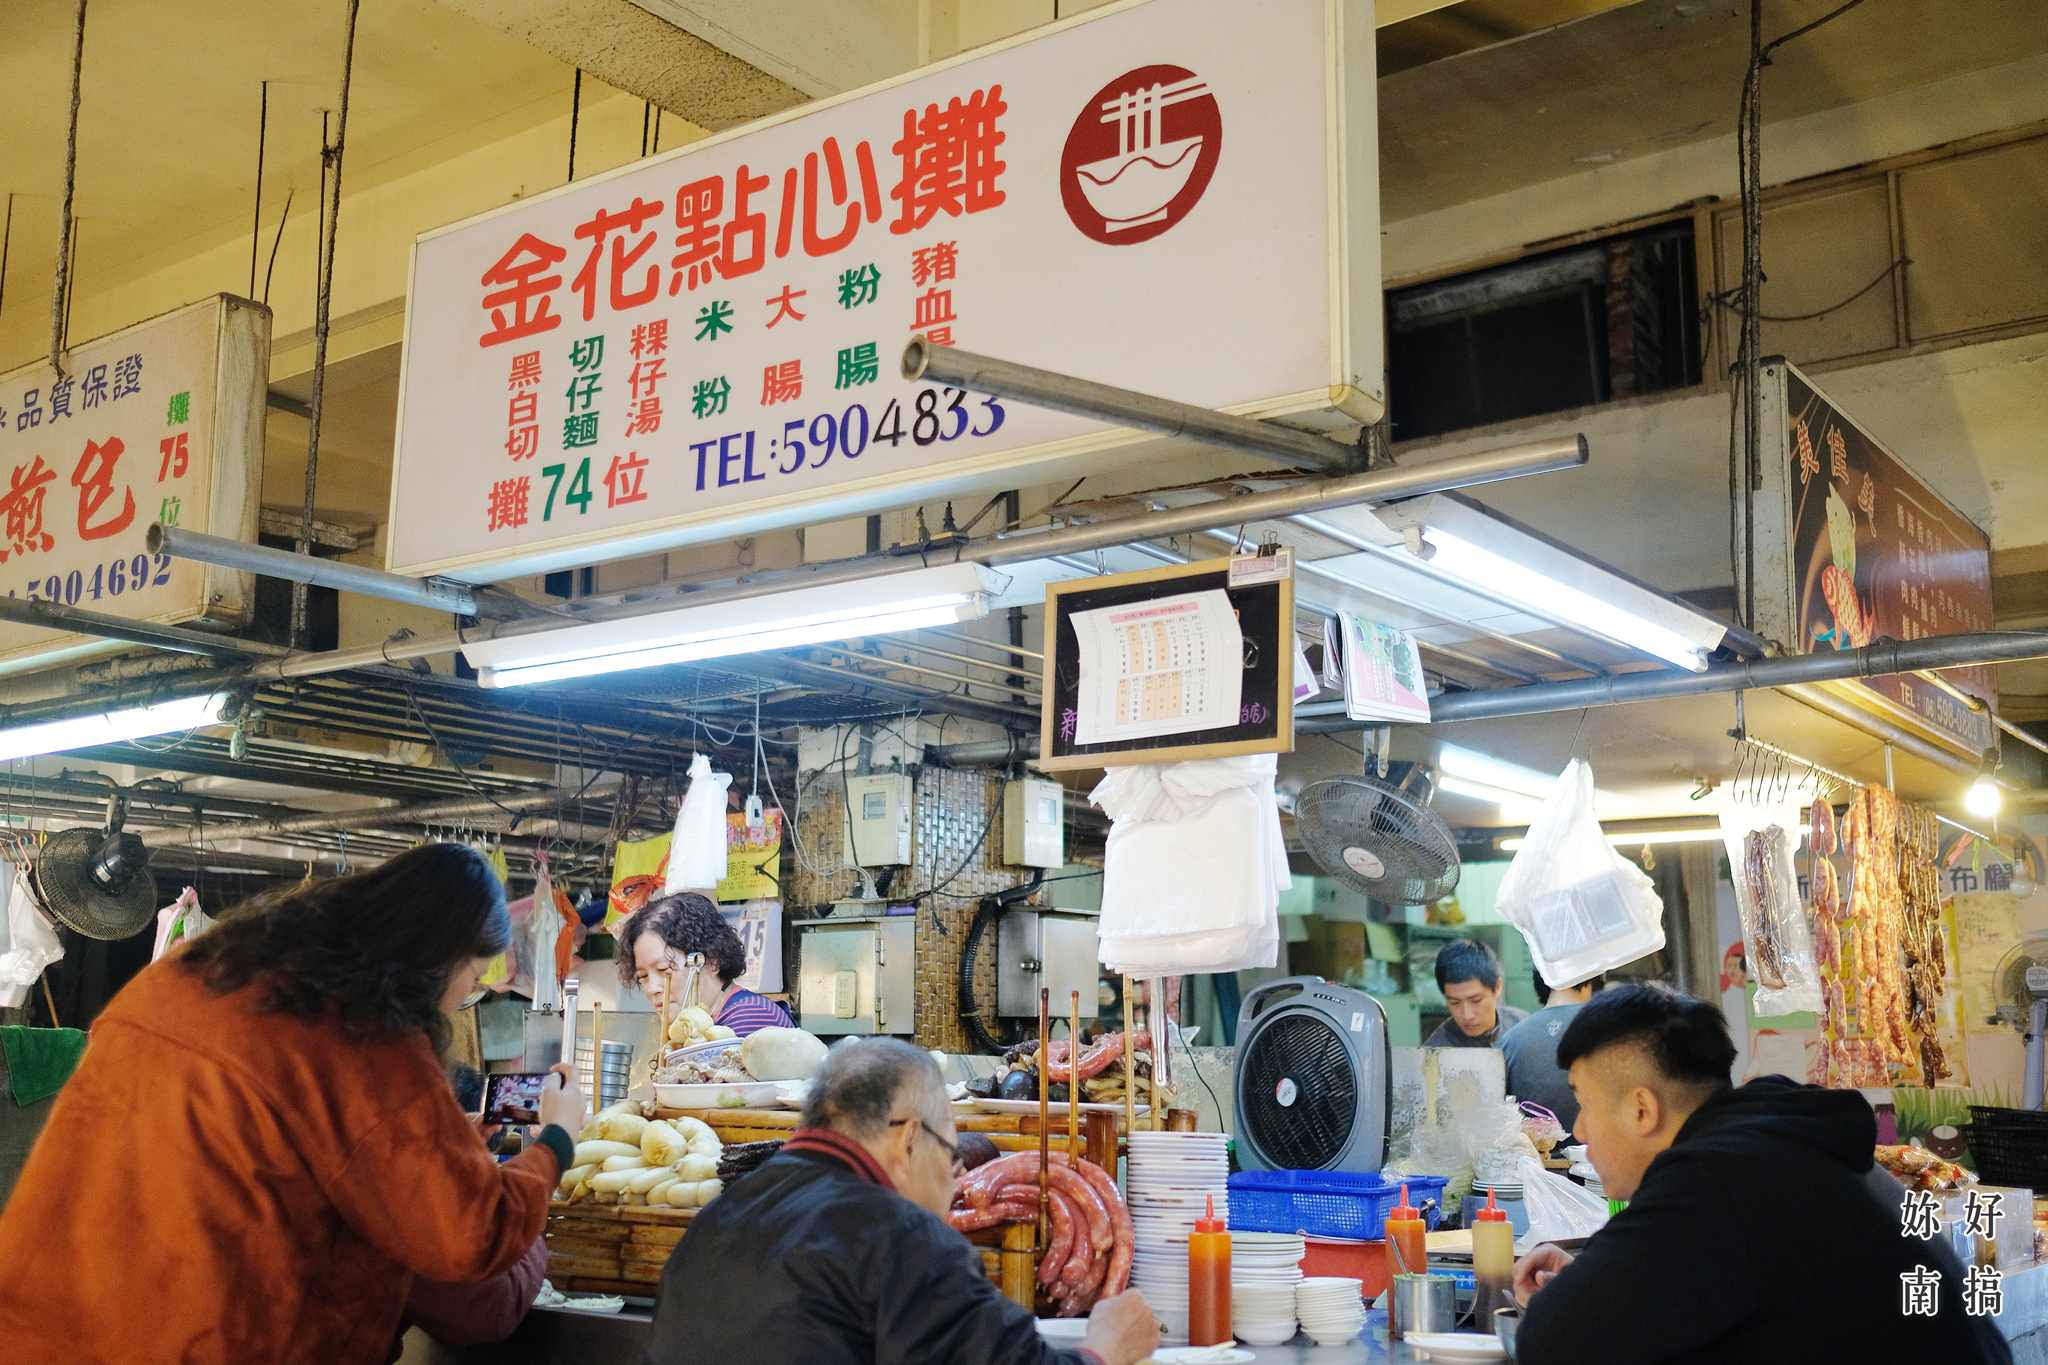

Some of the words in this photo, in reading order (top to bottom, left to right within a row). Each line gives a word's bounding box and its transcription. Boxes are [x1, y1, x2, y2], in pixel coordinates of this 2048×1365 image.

[478, 83, 1009, 349] 金花點心攤
[624, 318, 669, 439] 粿仔湯
[691, 300, 735, 420] 米粉
[760, 284, 808, 407] 大腸
[834, 262, 881, 391] 粉腸
[0, 352, 143, 433] 品質保證
[504, 350, 543, 463] 黑白切
[562, 334, 605, 450] 切仔麵
